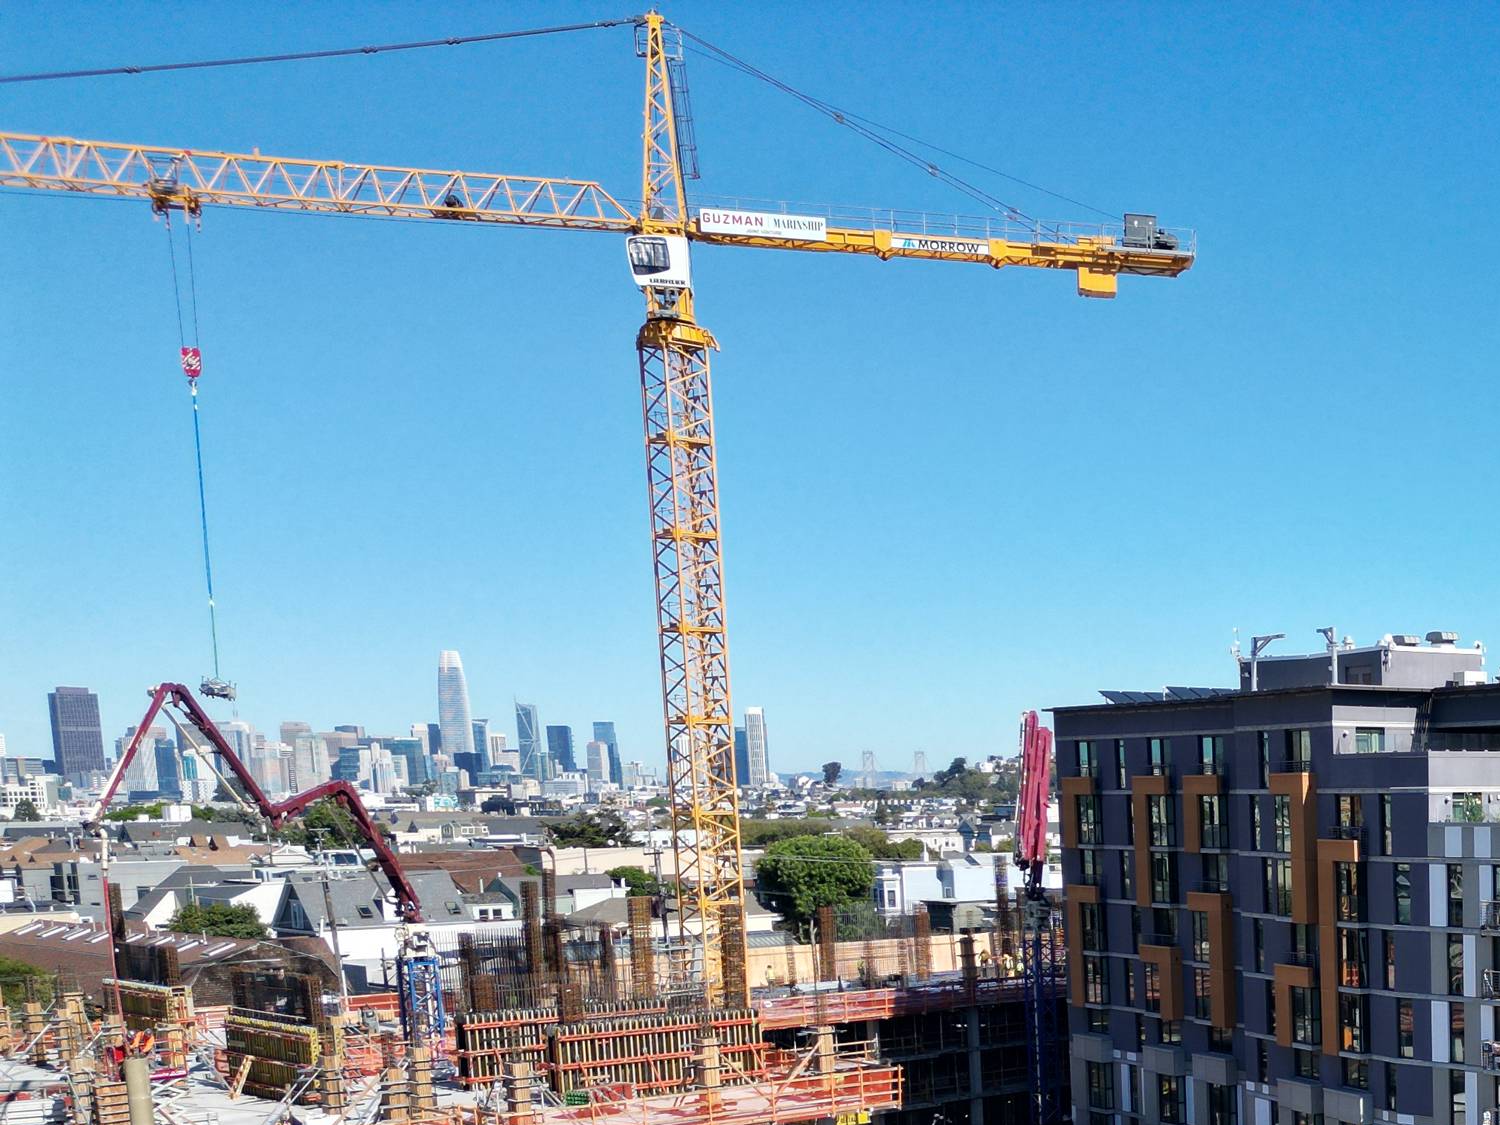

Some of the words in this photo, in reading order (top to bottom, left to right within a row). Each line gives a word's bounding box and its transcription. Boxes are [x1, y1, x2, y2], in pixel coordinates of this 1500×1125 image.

[702, 212, 764, 227] GUZMAN
[773, 218, 824, 232] MARINSHIP
[918, 240, 980, 253] MORROW
